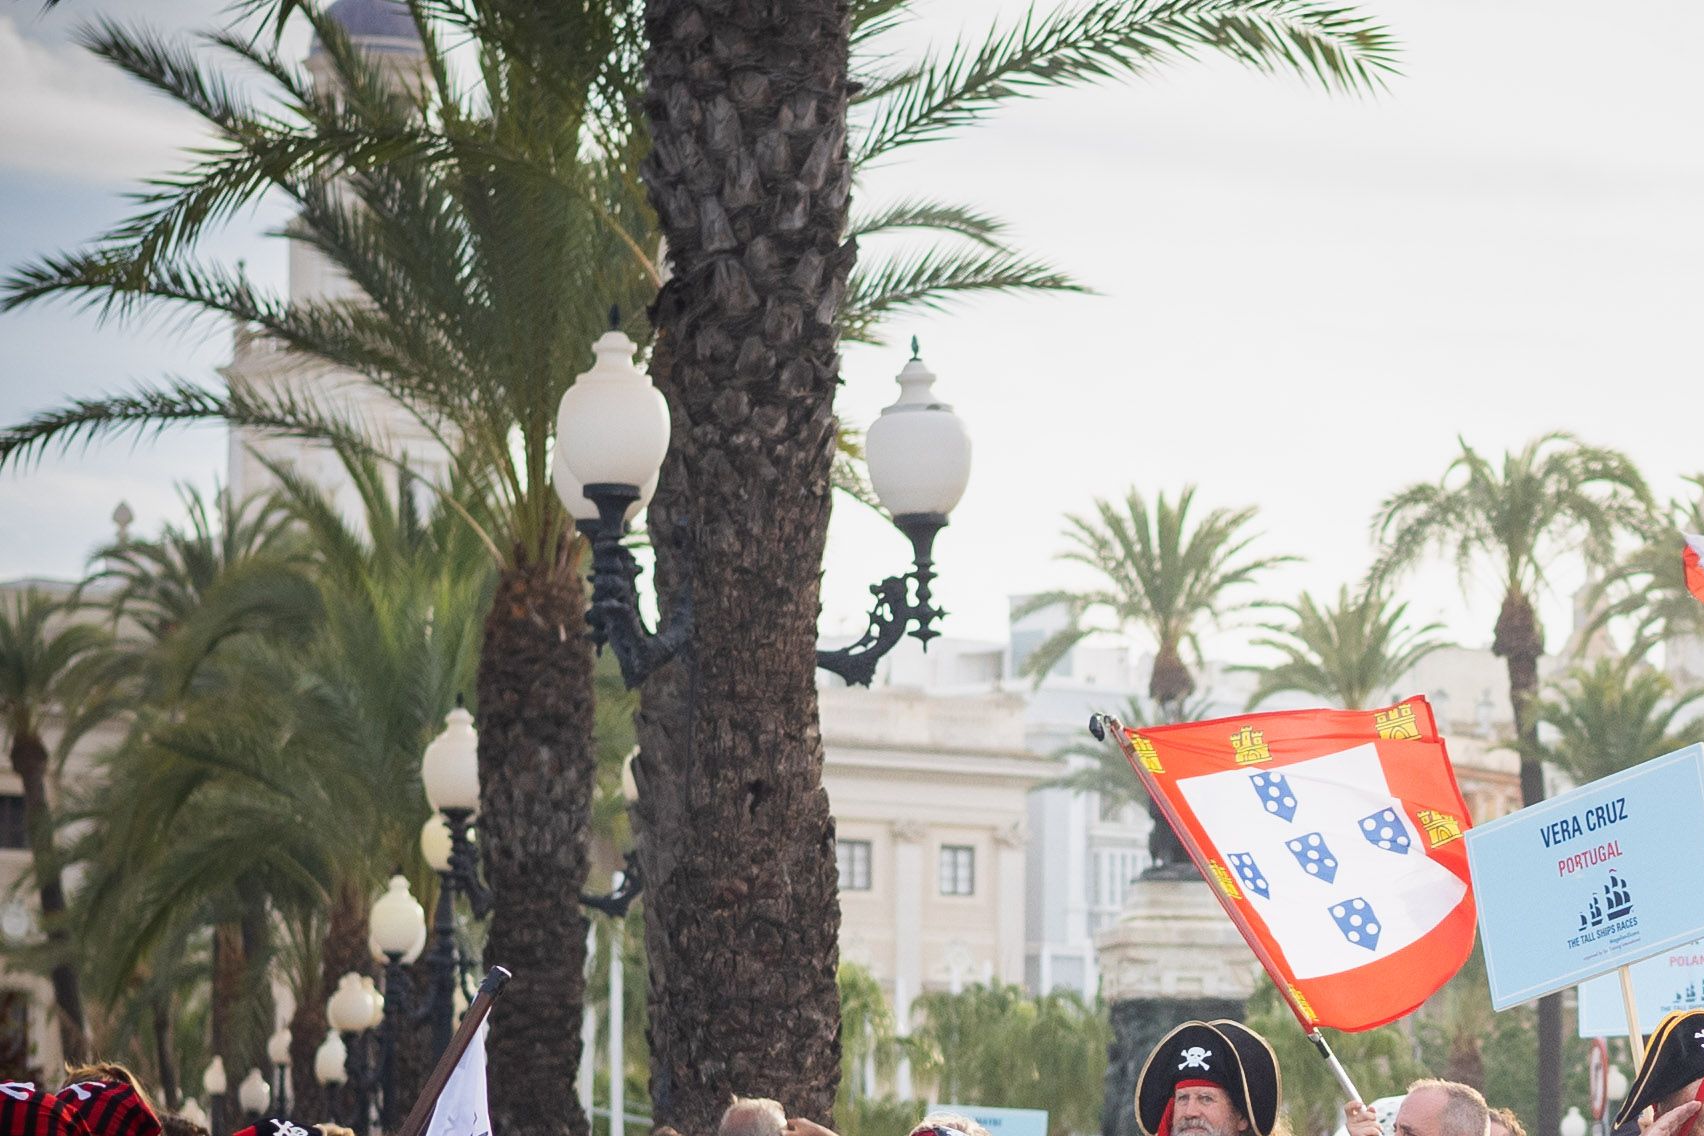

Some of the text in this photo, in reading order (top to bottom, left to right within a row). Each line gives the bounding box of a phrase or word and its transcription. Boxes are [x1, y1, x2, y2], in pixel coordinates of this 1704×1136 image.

[1540, 797, 1628, 848] VERA CRUZ
[1558, 840, 1623, 878] PORTUGAL
[1567, 937, 1580, 949] THE
[1580, 932, 1596, 944] TALL
[1596, 925, 1616, 939] SHIPS
[1617, 917, 1638, 932] RACES
